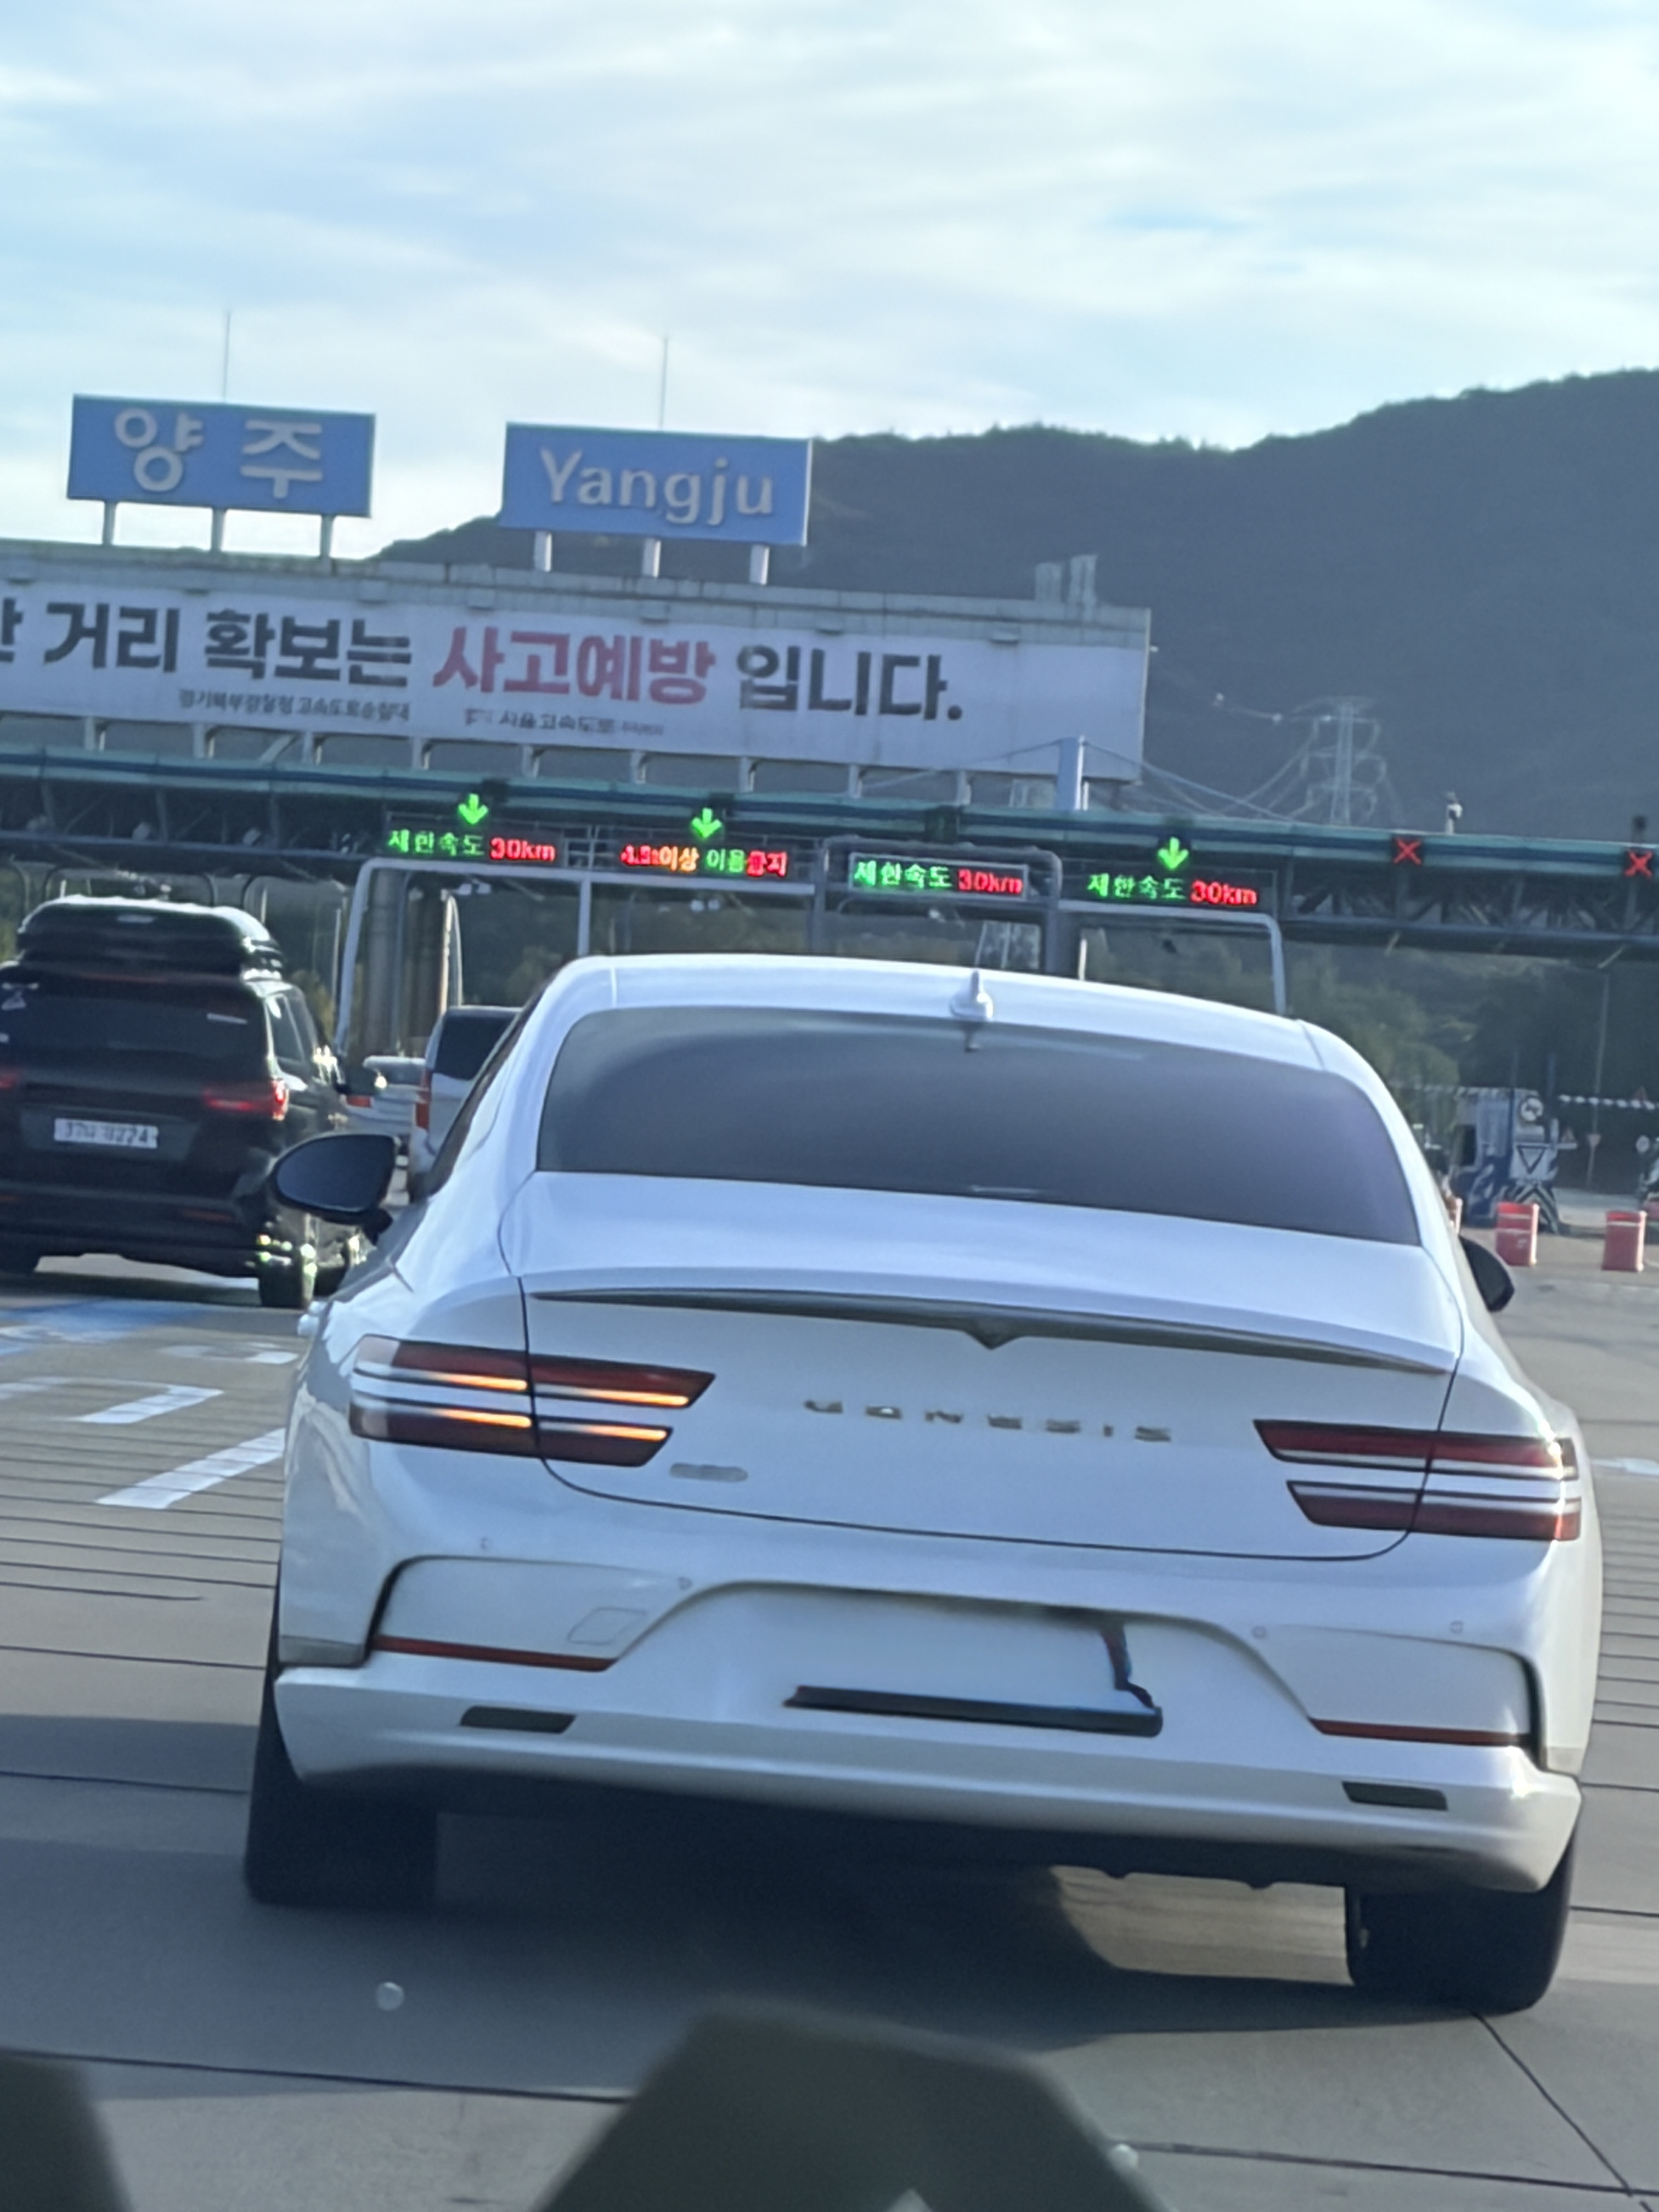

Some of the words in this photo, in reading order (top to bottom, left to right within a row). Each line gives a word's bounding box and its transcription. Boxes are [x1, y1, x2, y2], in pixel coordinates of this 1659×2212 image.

[114, 407, 323, 498] 양주
[540, 446, 774, 527] Yangju
[43, 601, 180, 673] 거리
[204, 609, 411, 688] 확보는
[432, 626, 716, 706] 사고예방
[736, 645, 962, 721] 입니다.
[489, 837, 556, 862] 30km
[957, 868, 1023, 894] 30km
[1190, 879, 1257, 905] 30km
